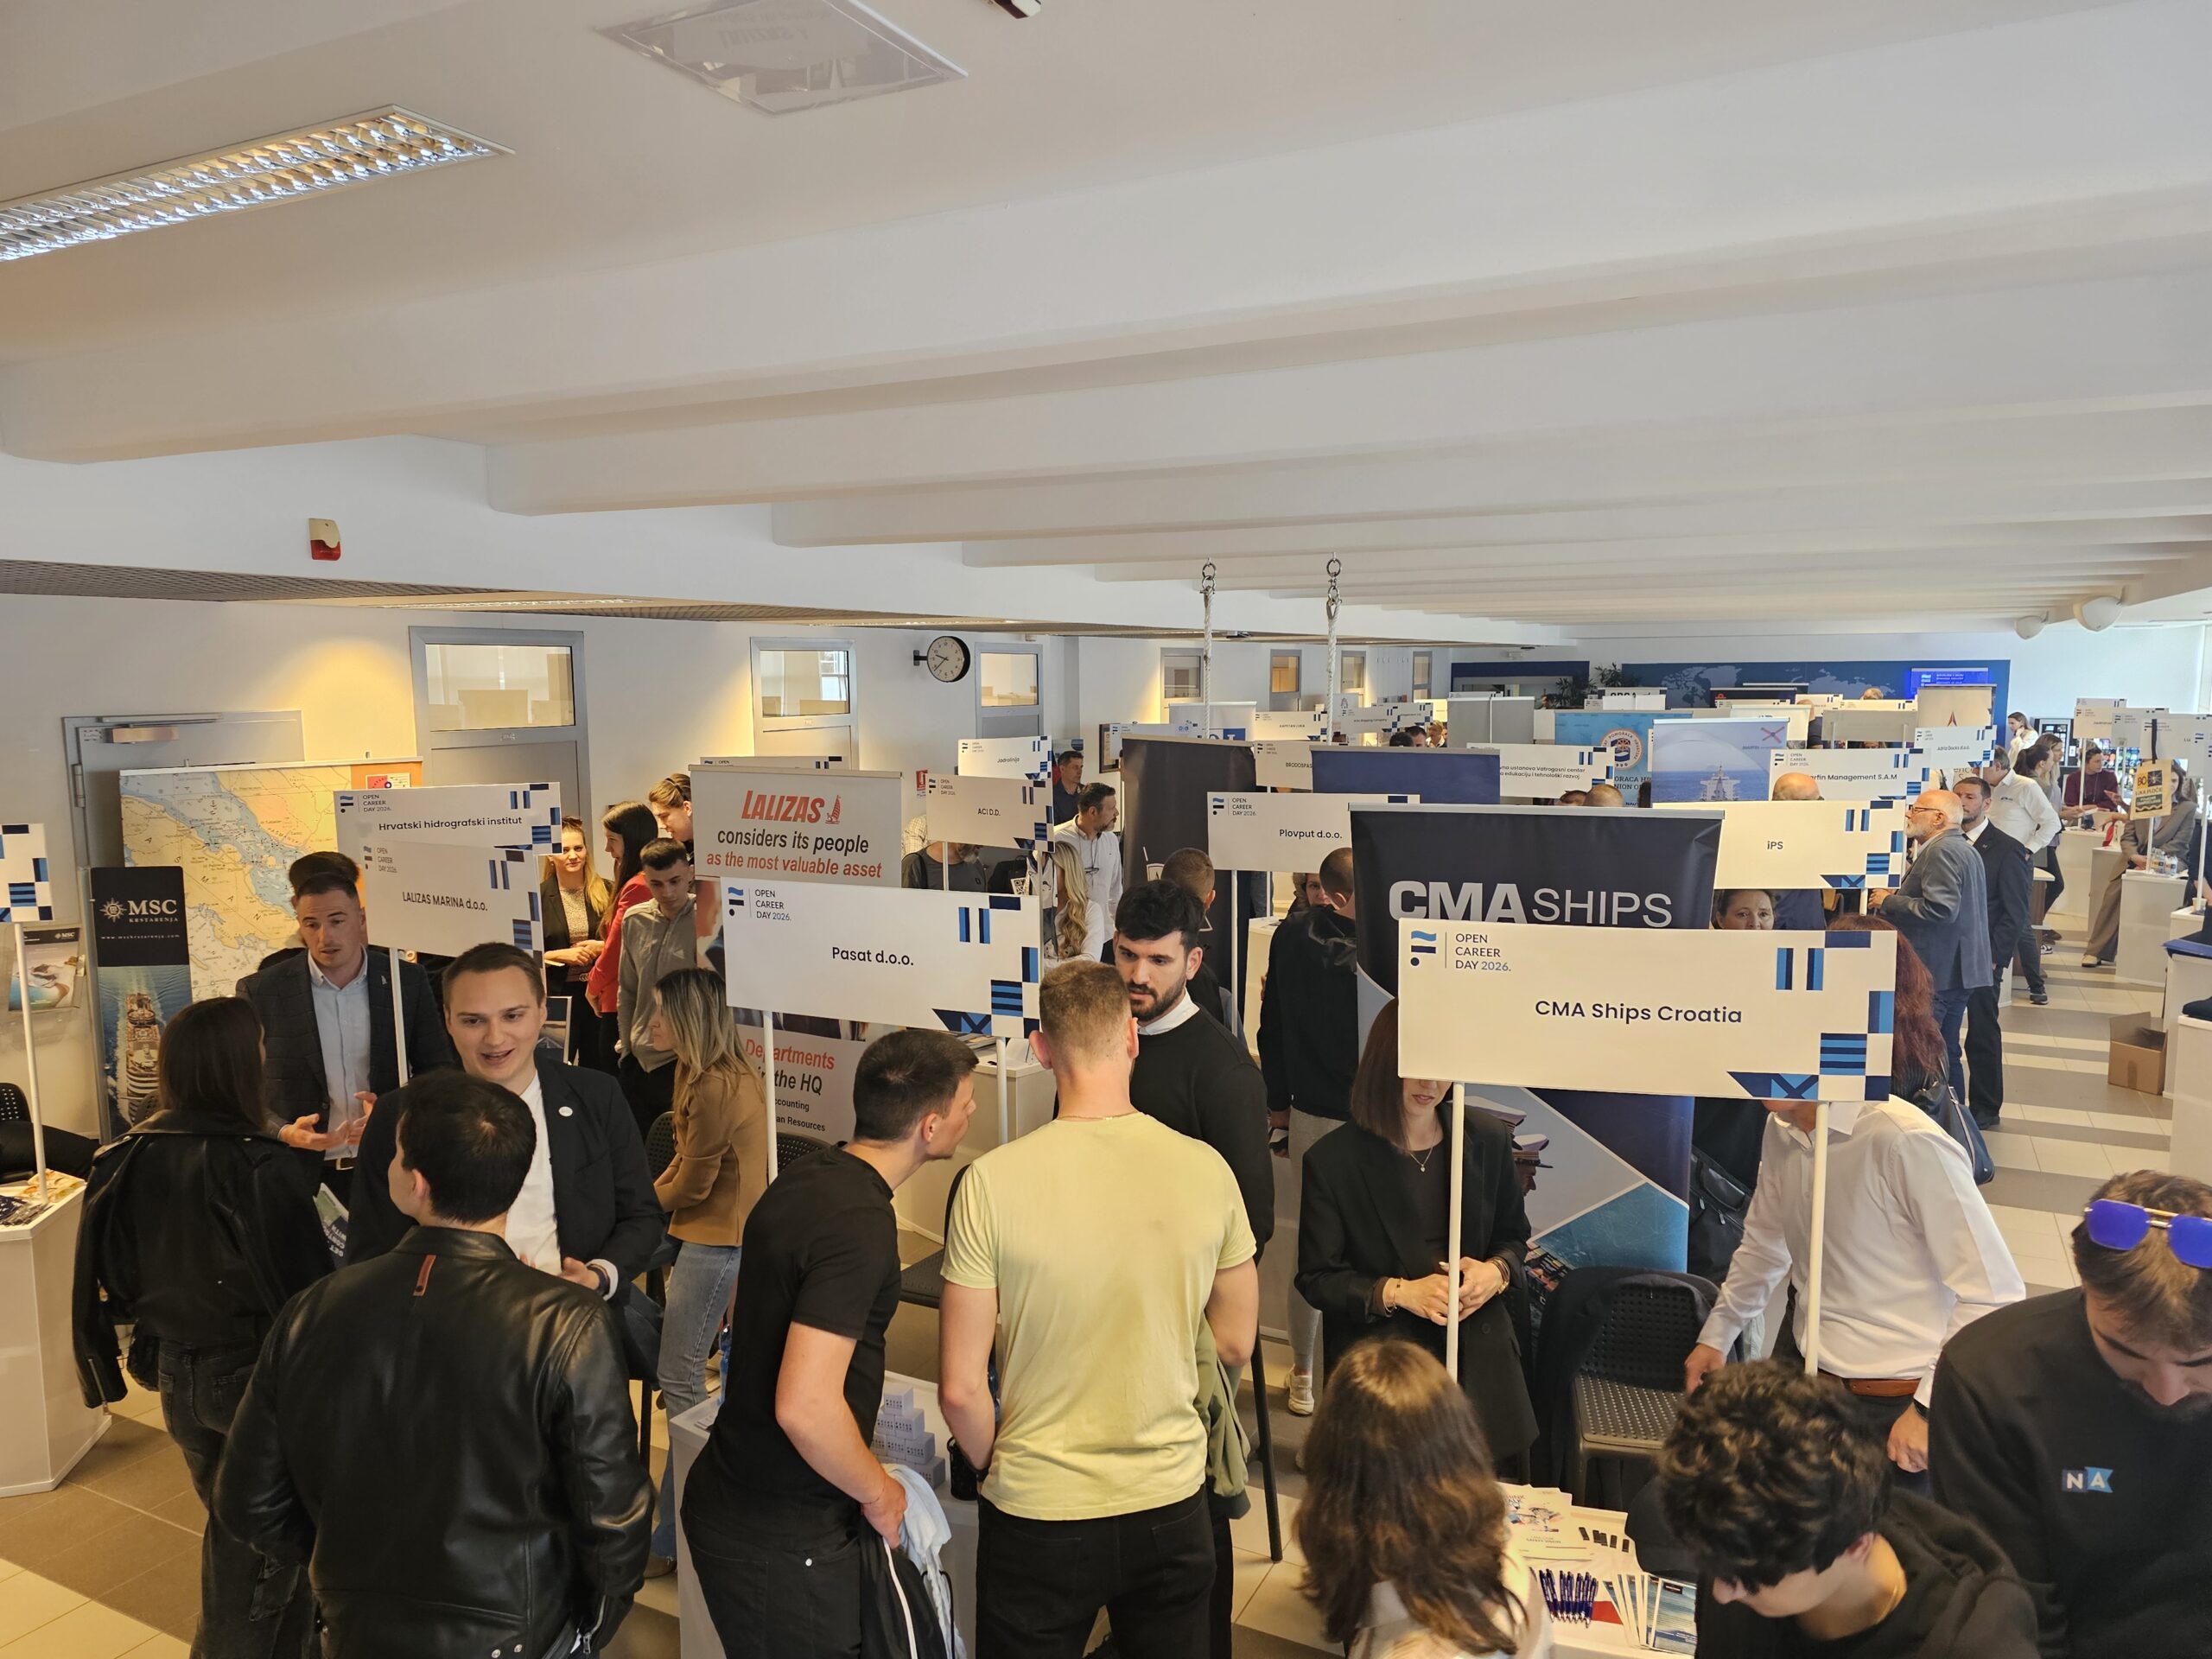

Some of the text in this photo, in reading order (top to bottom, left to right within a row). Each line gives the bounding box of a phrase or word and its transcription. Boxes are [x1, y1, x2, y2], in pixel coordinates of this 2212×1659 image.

[1827, 774, 1877, 783] Management
[741, 790, 825, 823] LALIZAS
[989, 808, 1001, 817] D.D.
[378, 816, 523, 831] Hrvatski hidrografski institut
[1279, 829, 1343, 840] Plovput d.o.o.
[717, 828, 869, 857] considers its people
[1767, 840, 1783, 850] iPS
[377, 855, 393, 864] CAREER
[706, 851, 882, 879] as the most valuable asset
[378, 864, 387, 873] DAY
[754, 888, 776, 898] OPEN
[127, 899, 178, 916] MSC
[402, 891, 488, 912] LALIZAS MARINA d.o.o.
[755, 899, 785, 910] CAREER
[1389, 880, 1673, 928] CMA SHIPS
[756, 911, 792, 921] DAY 2026.
[1455, 933, 1488, 944] OPEN
[831, 946, 914, 966] Pasat d.o.o.
[1455, 946, 1501, 958] CAREER
[1455, 959, 1512, 972] DAY 2026.
[1535, 1000, 1743, 1025] CMA Ships Croatia
[773, 1069, 797, 1090] the
[800, 1073, 823, 1096] HQ
[787, 1116, 826, 1133] Resources
